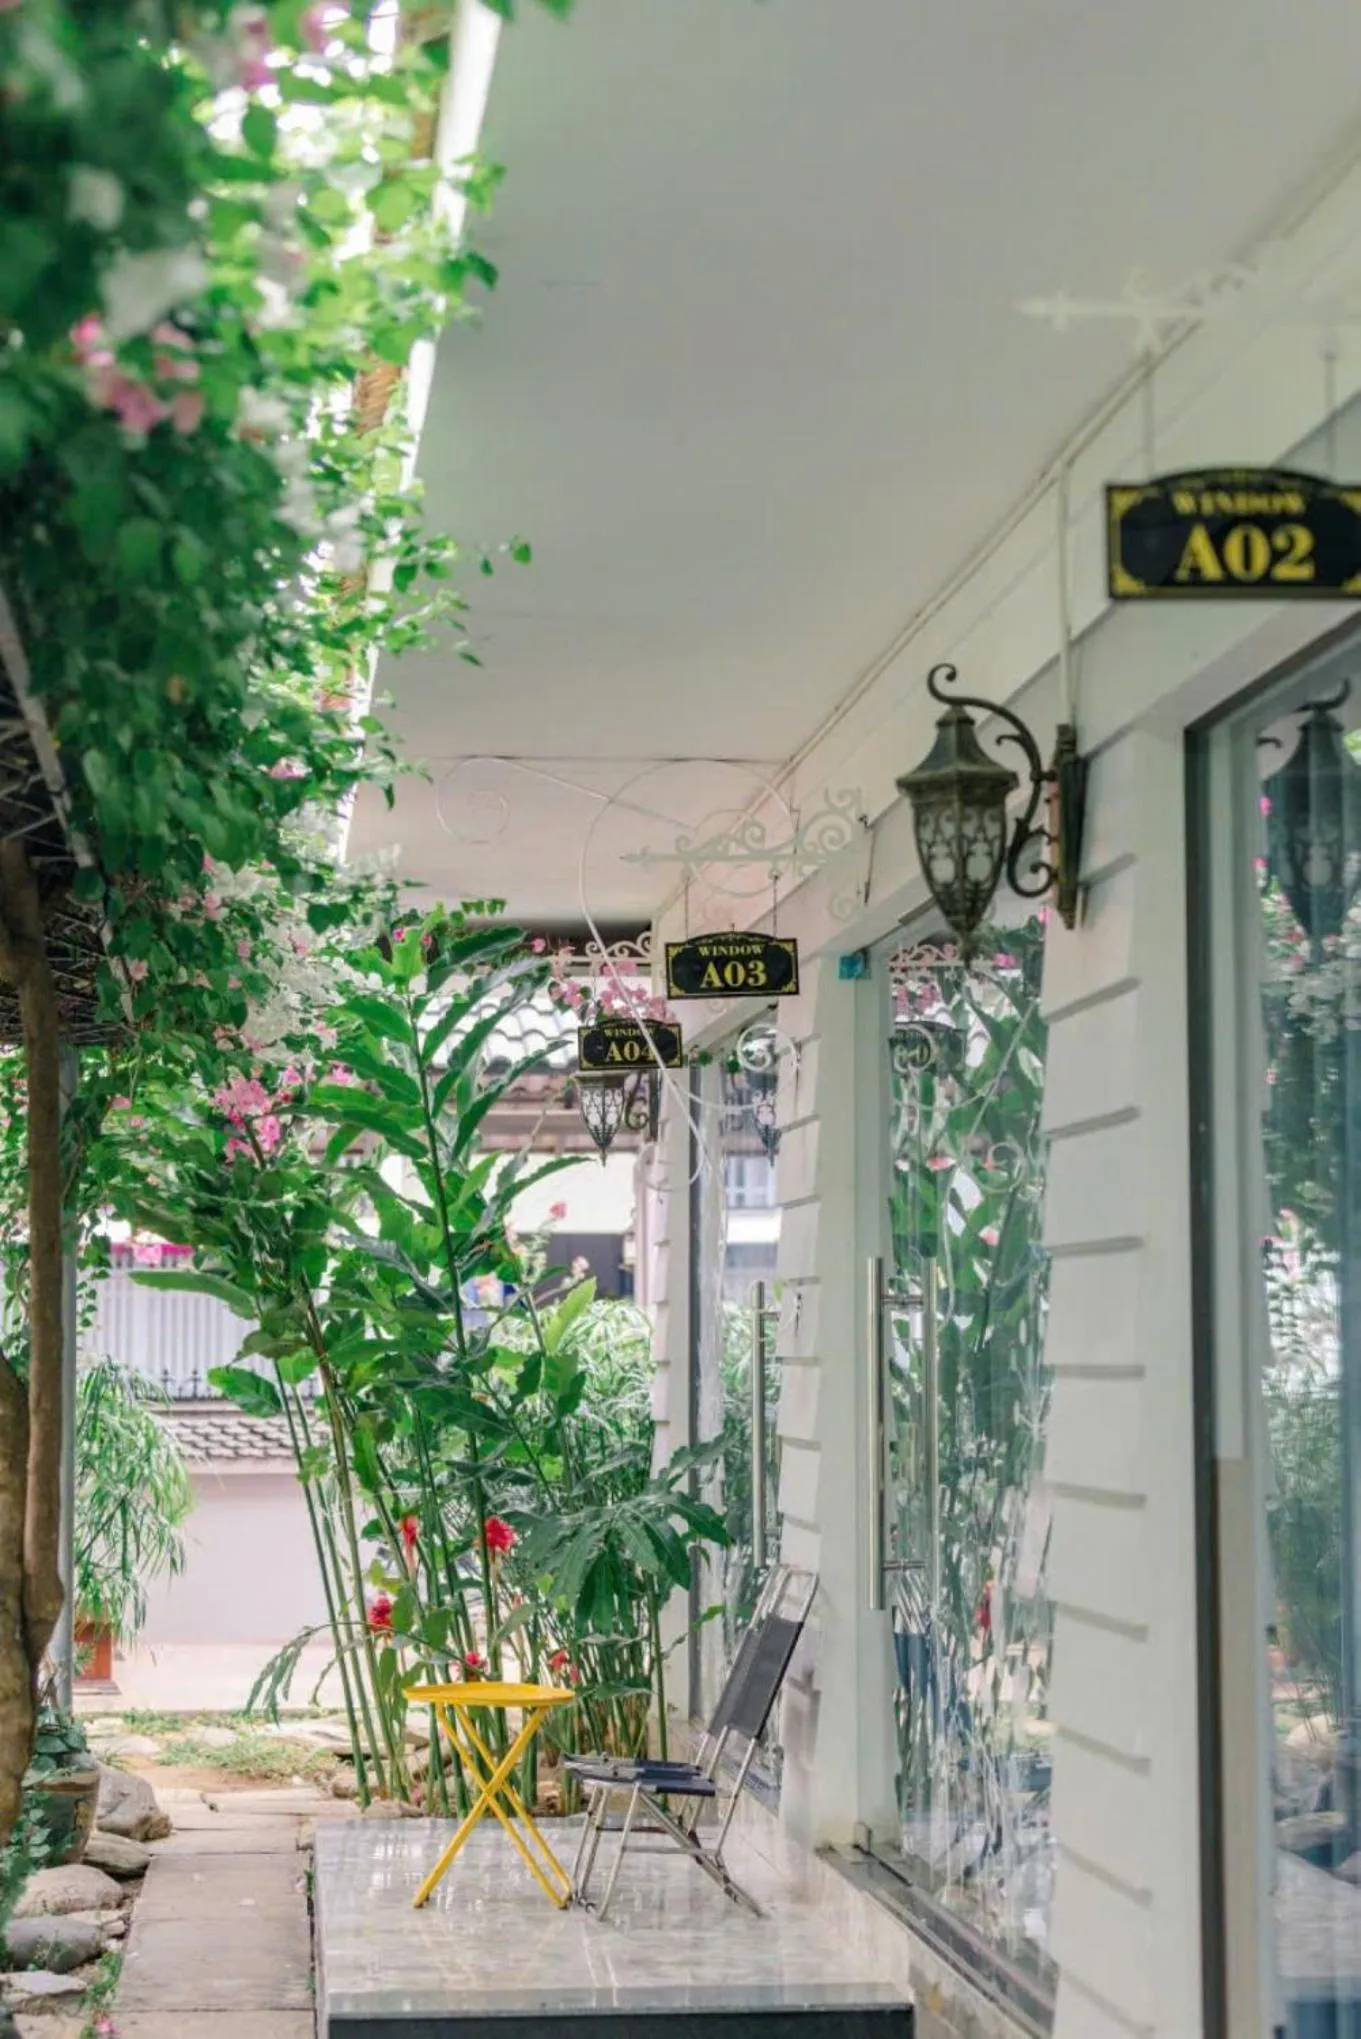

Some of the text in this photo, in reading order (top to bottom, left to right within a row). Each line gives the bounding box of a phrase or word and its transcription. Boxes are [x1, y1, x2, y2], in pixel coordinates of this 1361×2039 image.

[1173, 522, 1316, 582] A02
[698, 944, 765, 956] WINDOW
[700, 960, 767, 988] A03
